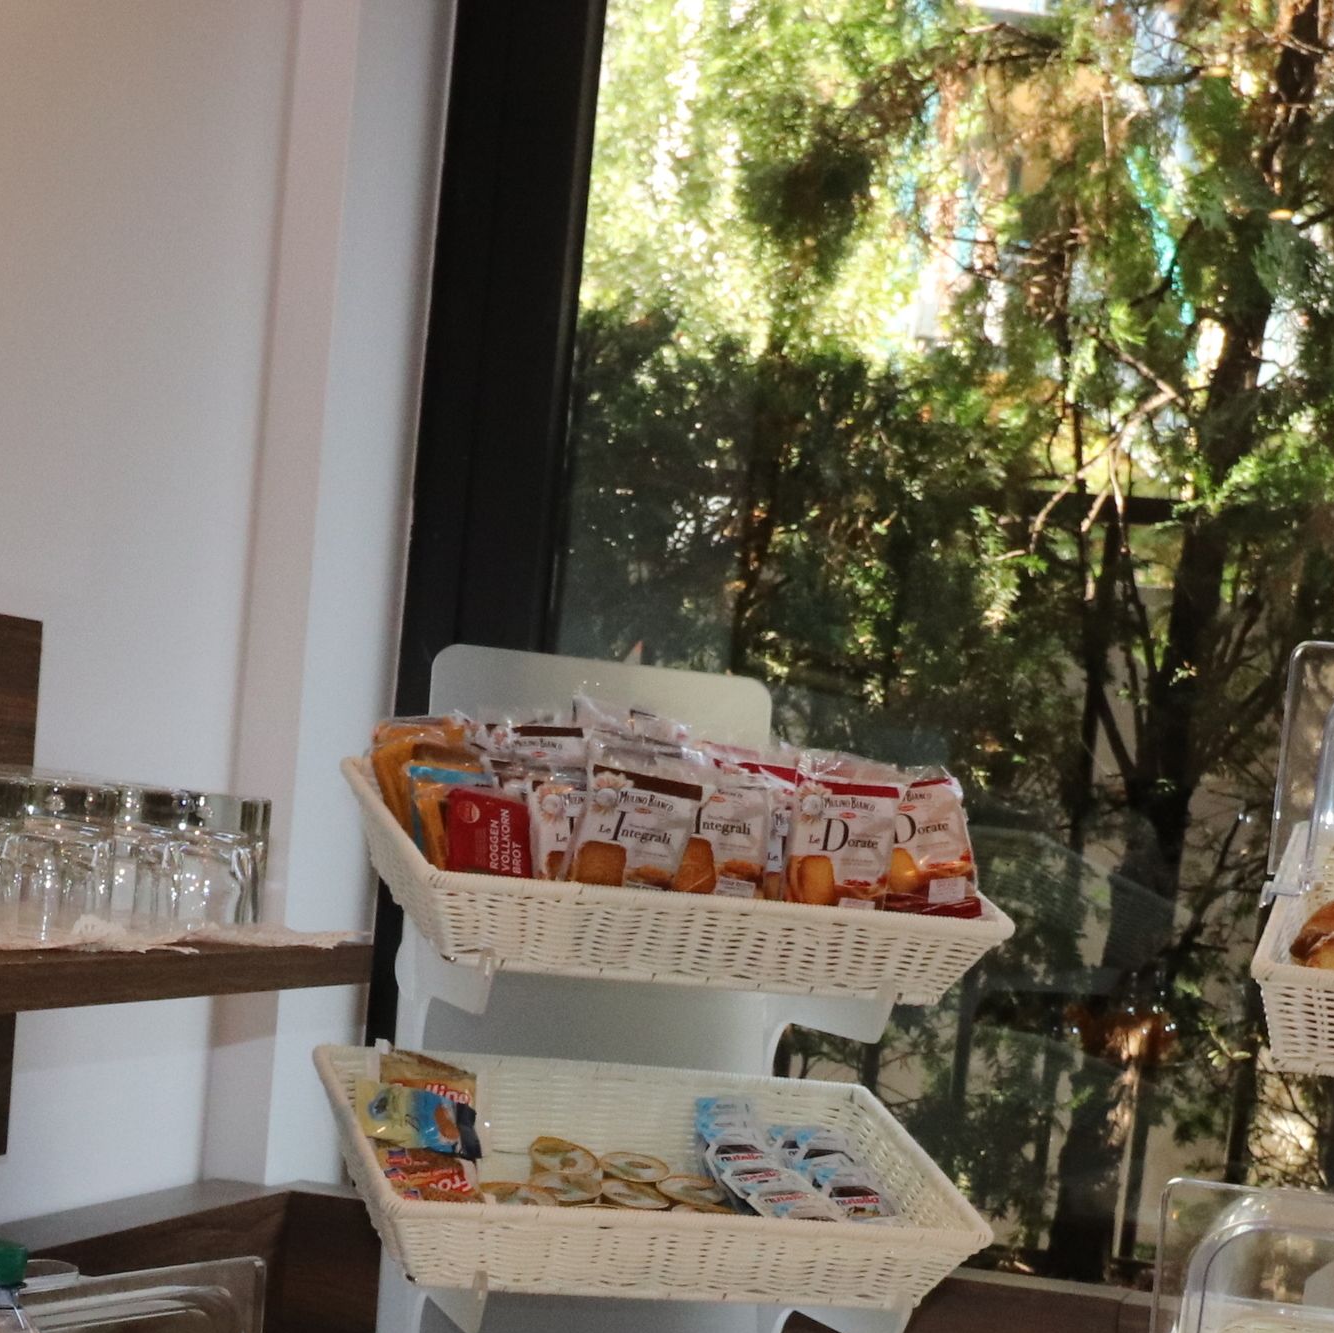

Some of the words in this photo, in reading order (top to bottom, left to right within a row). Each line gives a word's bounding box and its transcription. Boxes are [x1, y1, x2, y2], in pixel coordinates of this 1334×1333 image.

[489, 819, 499, 870] ROGGEN
[500, 808, 511, 871] VOLLKORN
[611, 811, 672, 845] Integrali
[821, 818, 878, 852] Dorate
[512, 842, 522, 874] BROT
